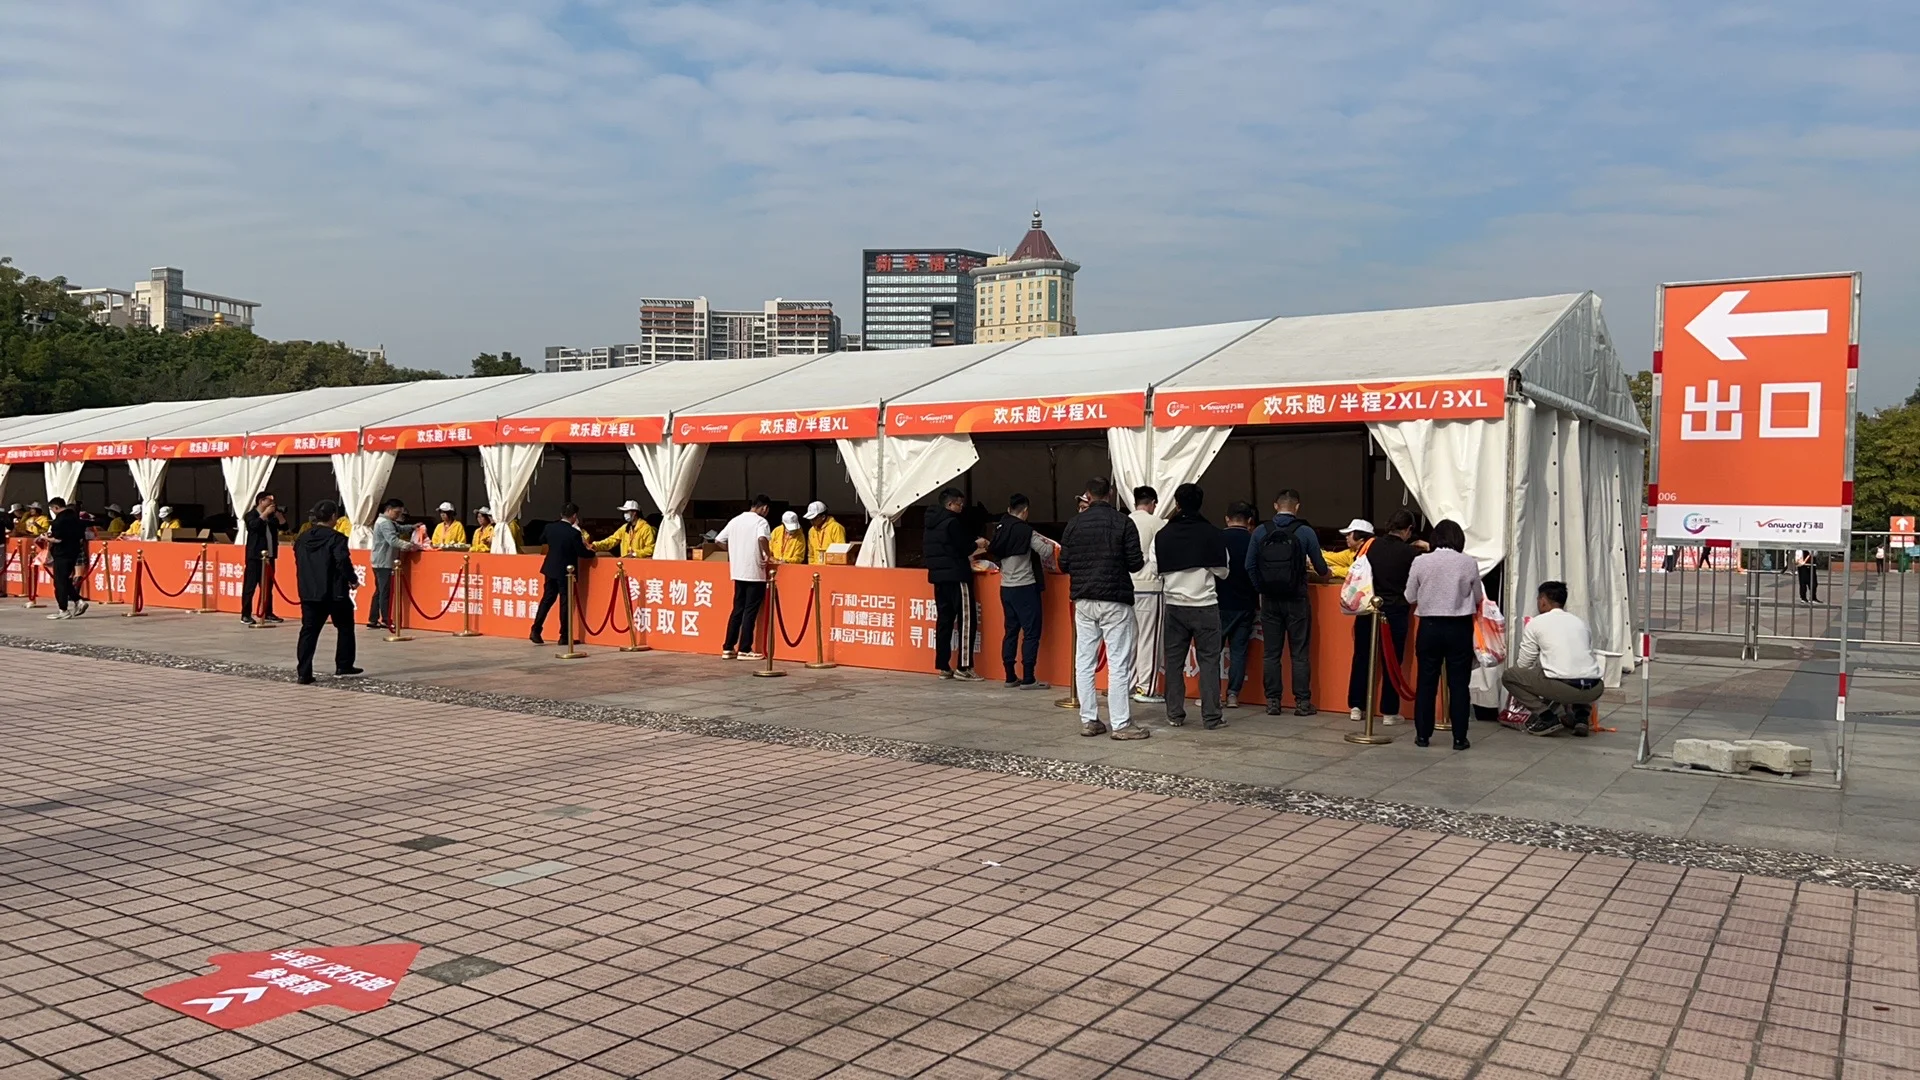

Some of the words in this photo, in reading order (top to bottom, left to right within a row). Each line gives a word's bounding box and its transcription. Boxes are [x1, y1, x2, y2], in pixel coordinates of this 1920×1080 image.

[1263, 389, 1488, 416] 欢乐跑/半程2XL/3XL
[1680, 379, 1822, 441] 出口
[993, 403, 1108, 425] 欢乐跑/半程XL
[569, 422, 636, 437] 欢乐跑/半程L
[759, 416, 849, 435] 欢乐跑/半程XL
[417, 428, 472, 443] 欢乐跑/半程L
[1658, 492, 1677, 501] 006
[831, 592, 896, 610] 万和·2025
[633, 607, 700, 637] 领取区
[843, 610, 895, 628] 顺德容桂
[830, 627, 895, 647] 环岛马拉松
[270, 949, 396, 992] 半程/欢乐跑
